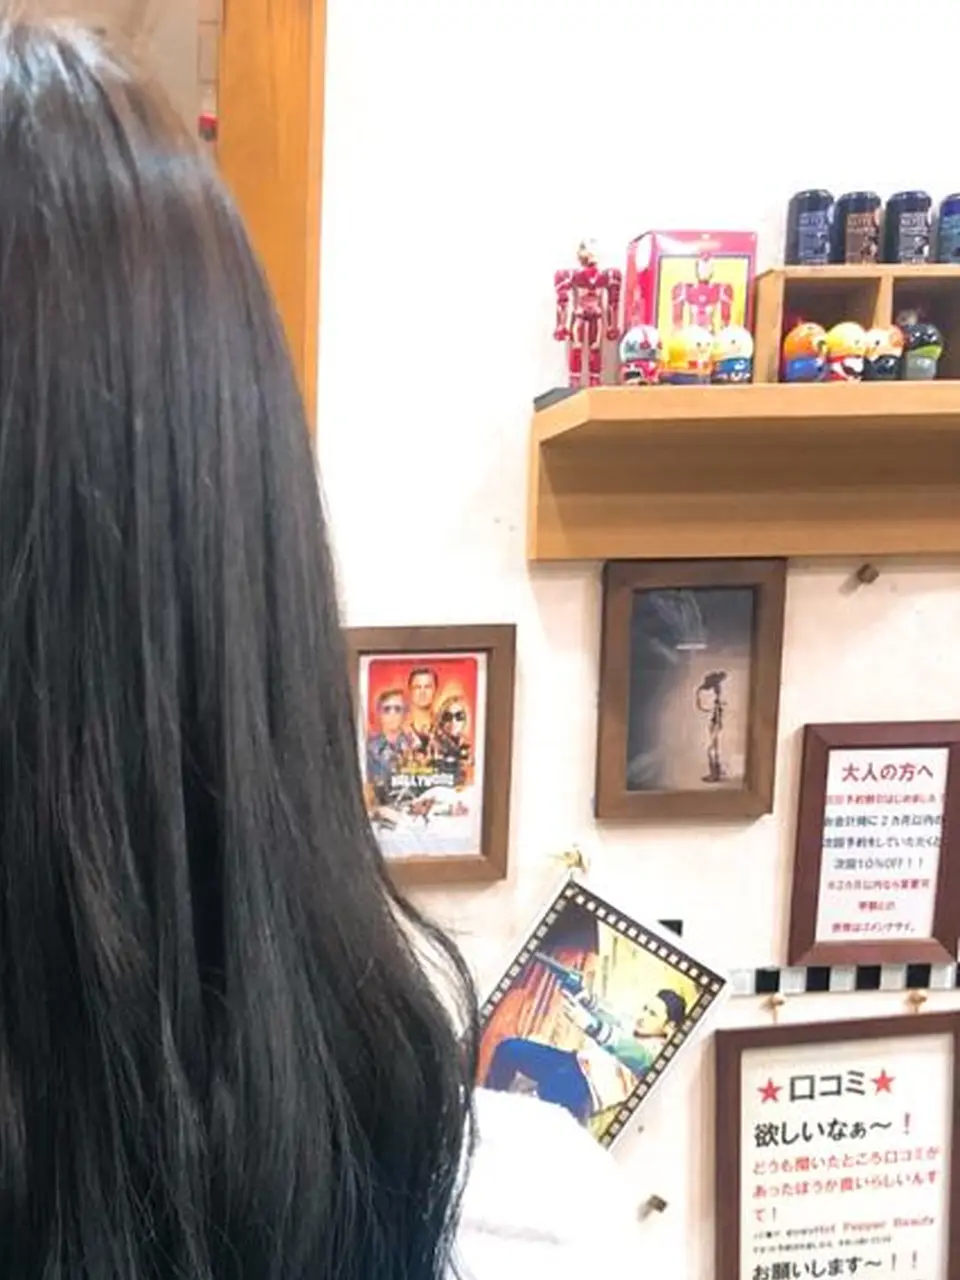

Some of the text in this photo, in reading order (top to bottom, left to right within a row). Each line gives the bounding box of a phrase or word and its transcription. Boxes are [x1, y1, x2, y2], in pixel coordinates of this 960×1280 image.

[842, 762, 934, 782] 大人の方へ
[789, 1070, 866, 1102] 口コミ
